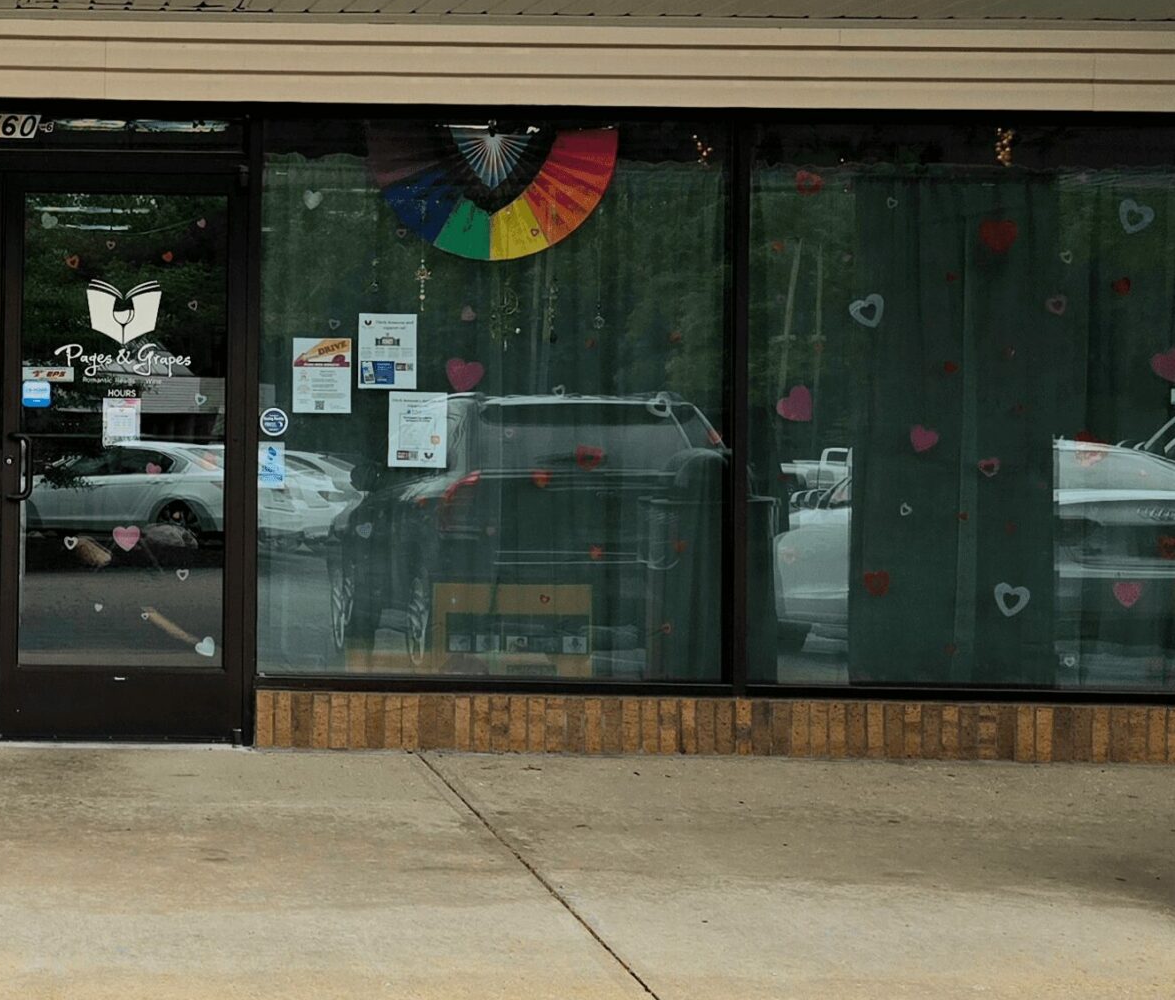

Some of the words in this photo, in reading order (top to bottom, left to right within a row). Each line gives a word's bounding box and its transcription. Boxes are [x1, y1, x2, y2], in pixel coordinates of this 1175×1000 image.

[317, 339, 349, 356] DRIVE
[54, 343, 113, 377] Pages
[116, 348, 134, 365] &
[132, 343, 192, 377] Grapes
[107, 389, 137, 398] HOURS
